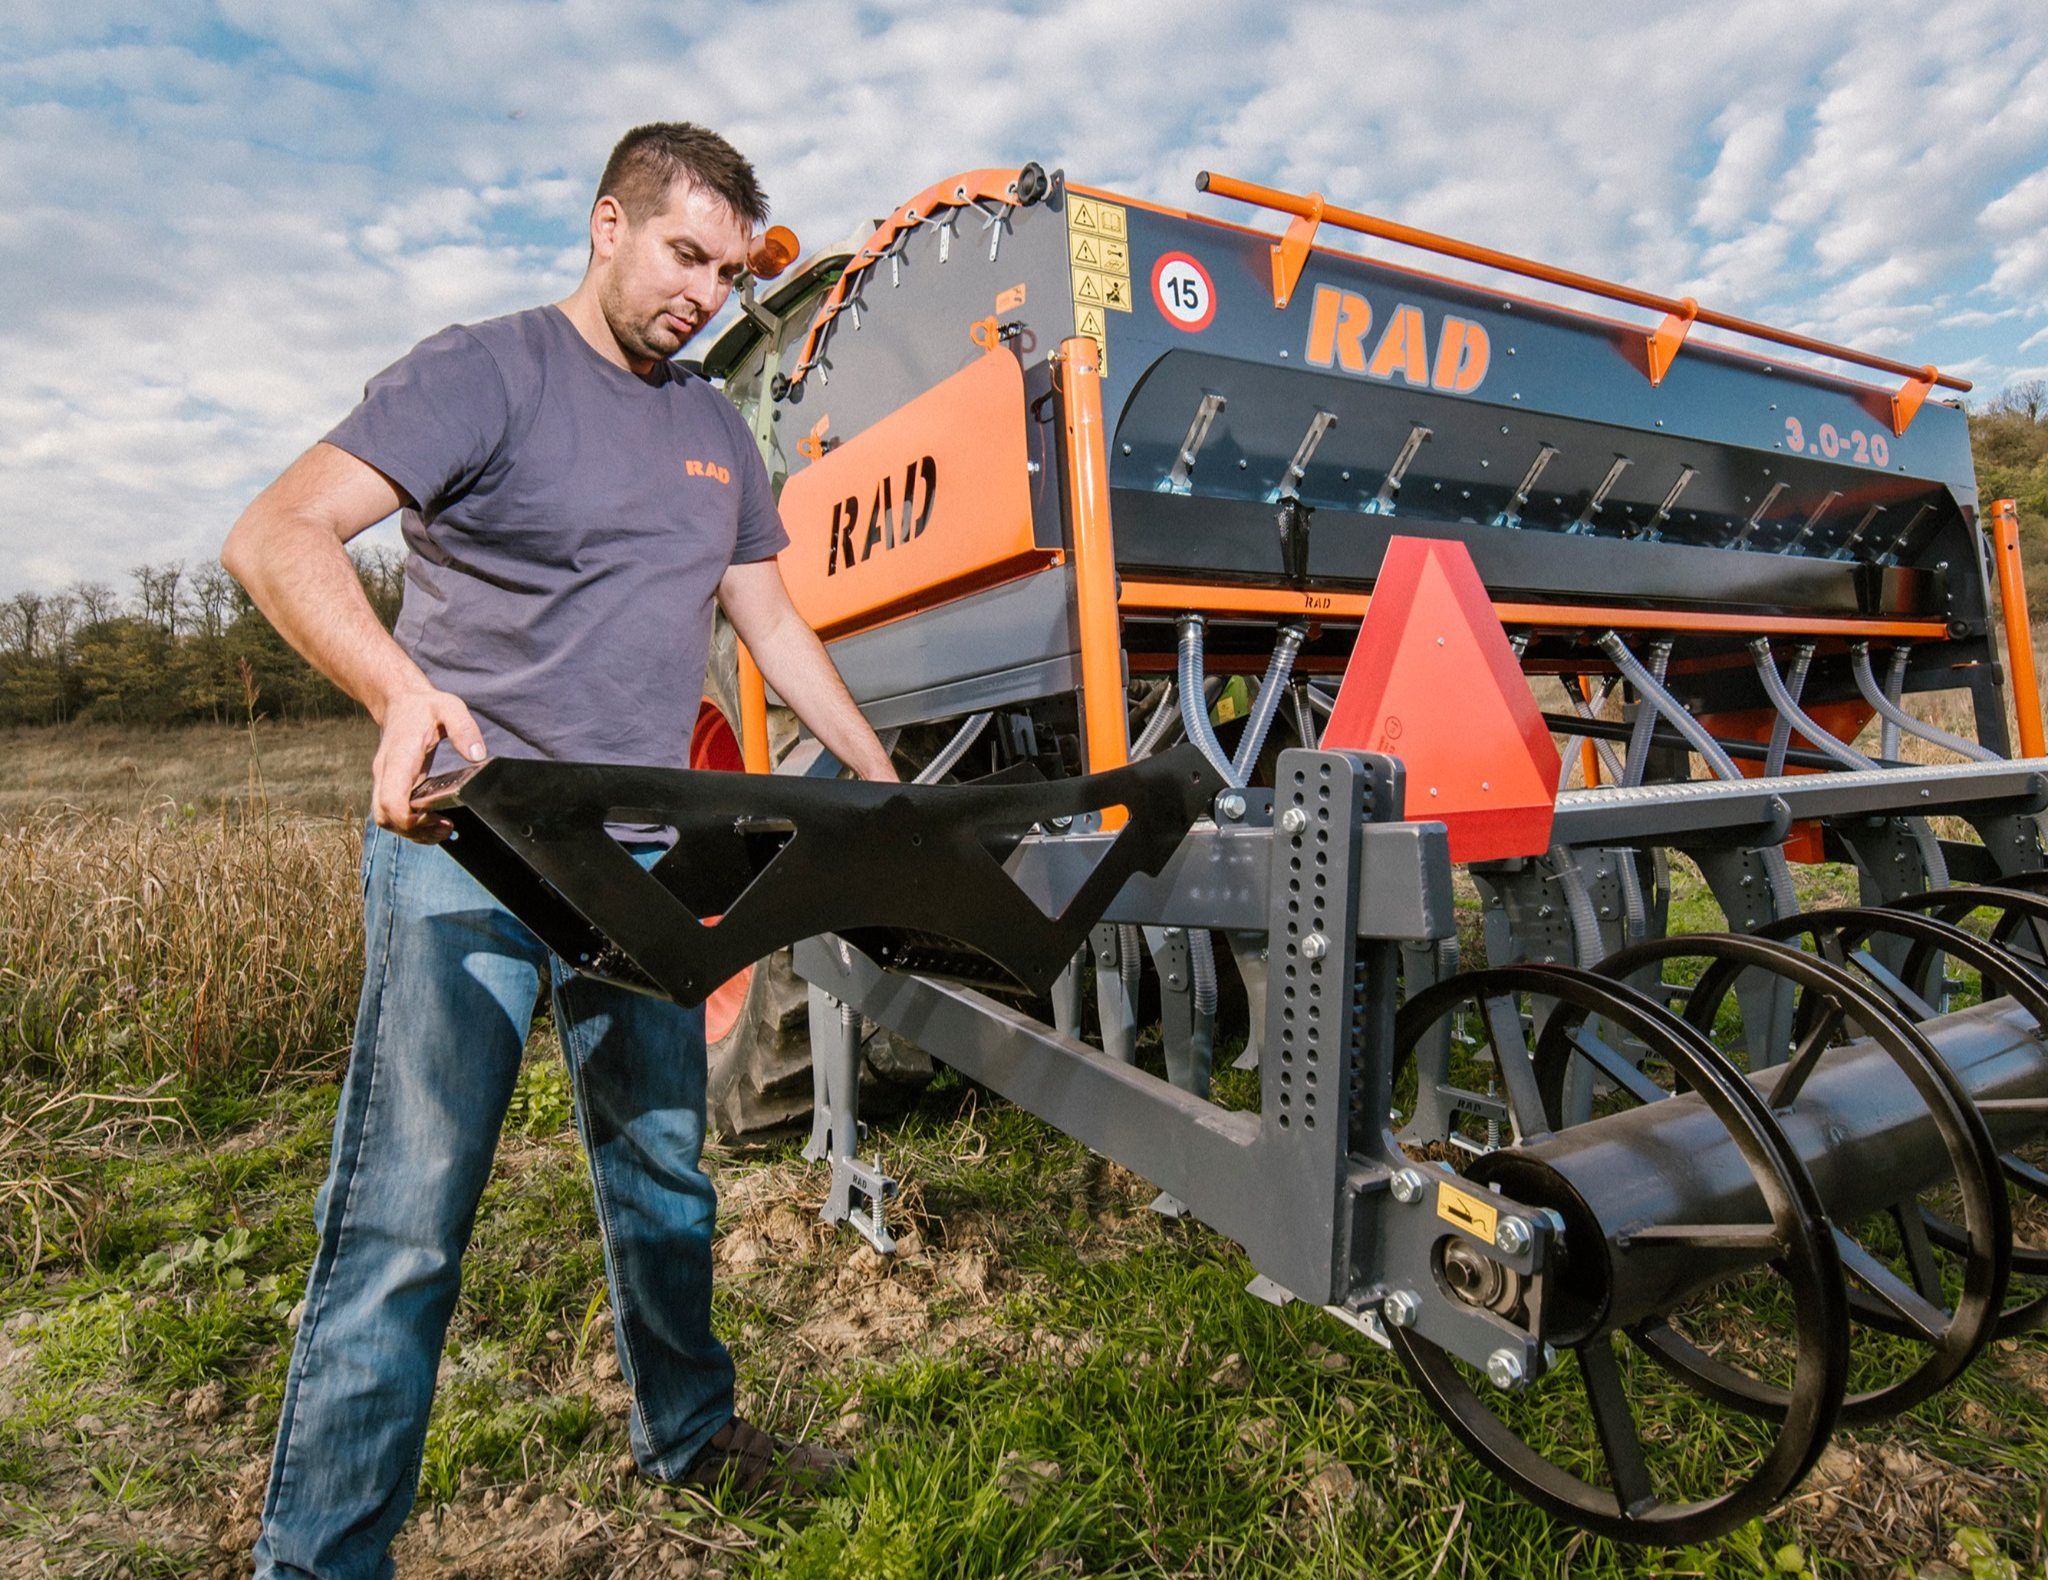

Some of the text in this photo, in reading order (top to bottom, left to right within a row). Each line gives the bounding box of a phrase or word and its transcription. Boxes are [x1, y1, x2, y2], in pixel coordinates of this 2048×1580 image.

[1167, 276, 1199, 310] 15
[1304, 282, 1491, 395] RAD
[1785, 416, 1889, 467] 3.0-20
[685, 460, 731, 485] RAD
[827, 455, 937, 577] RAD
[1305, 596, 1331, 609] RAD
[1457, 1099, 1482, 1113] RAD
[852, 1174, 868, 1190] RAD
